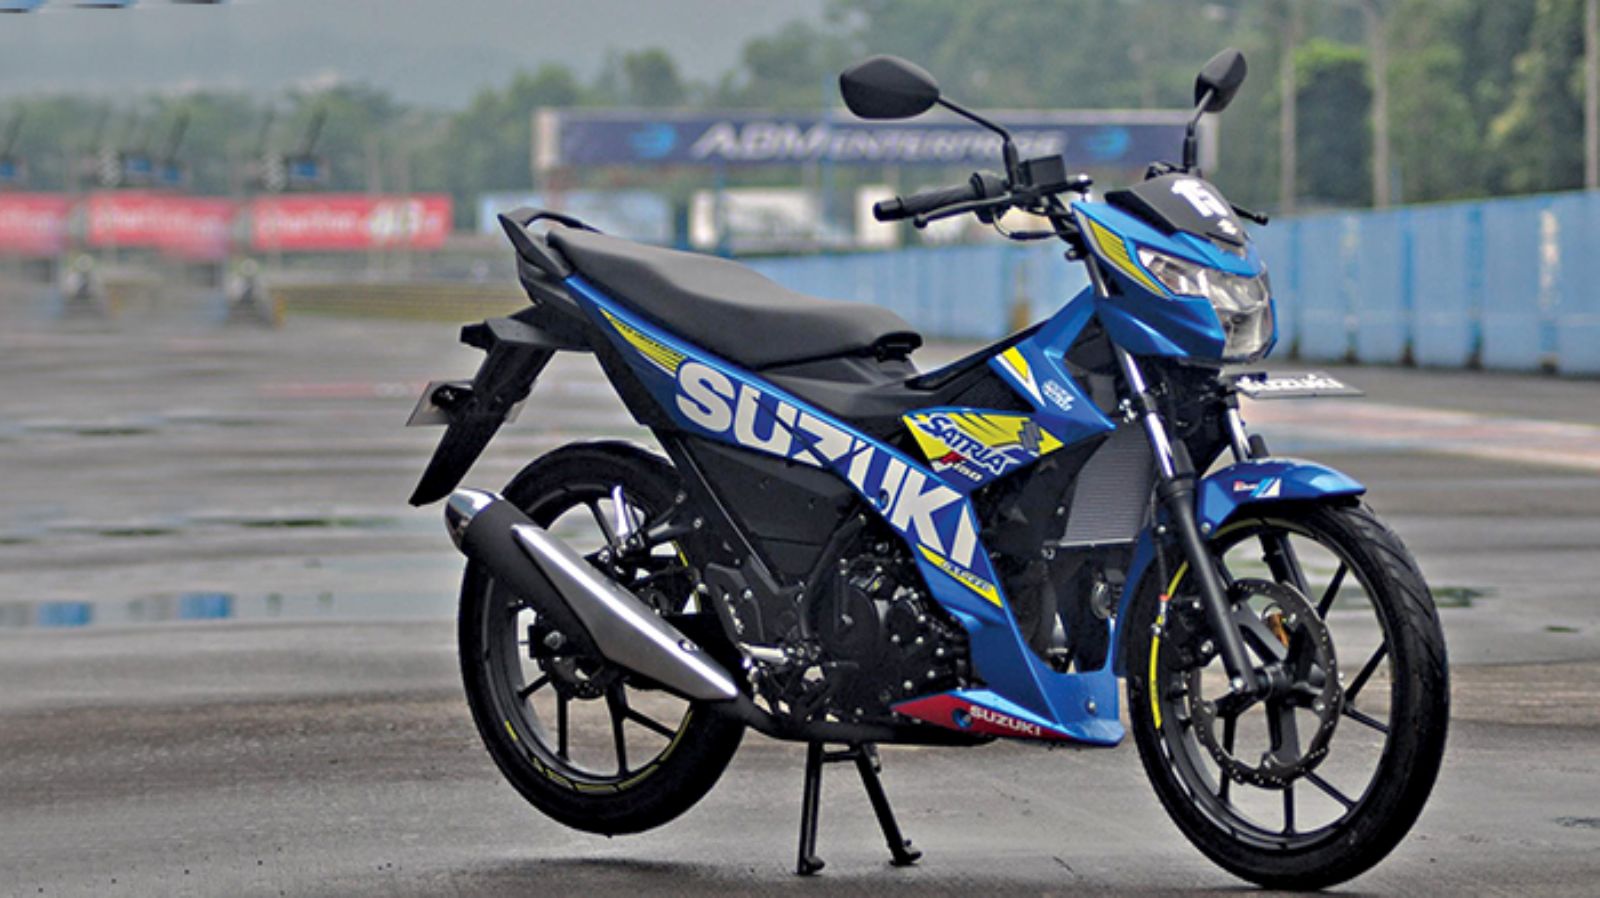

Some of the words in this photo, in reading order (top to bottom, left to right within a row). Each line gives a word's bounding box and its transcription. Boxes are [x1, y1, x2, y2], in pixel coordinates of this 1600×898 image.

[676, 362, 977, 568] SUZUKI
[917, 414, 1006, 474] SATRIA
[969, 704, 1042, 736] SUZUKI
